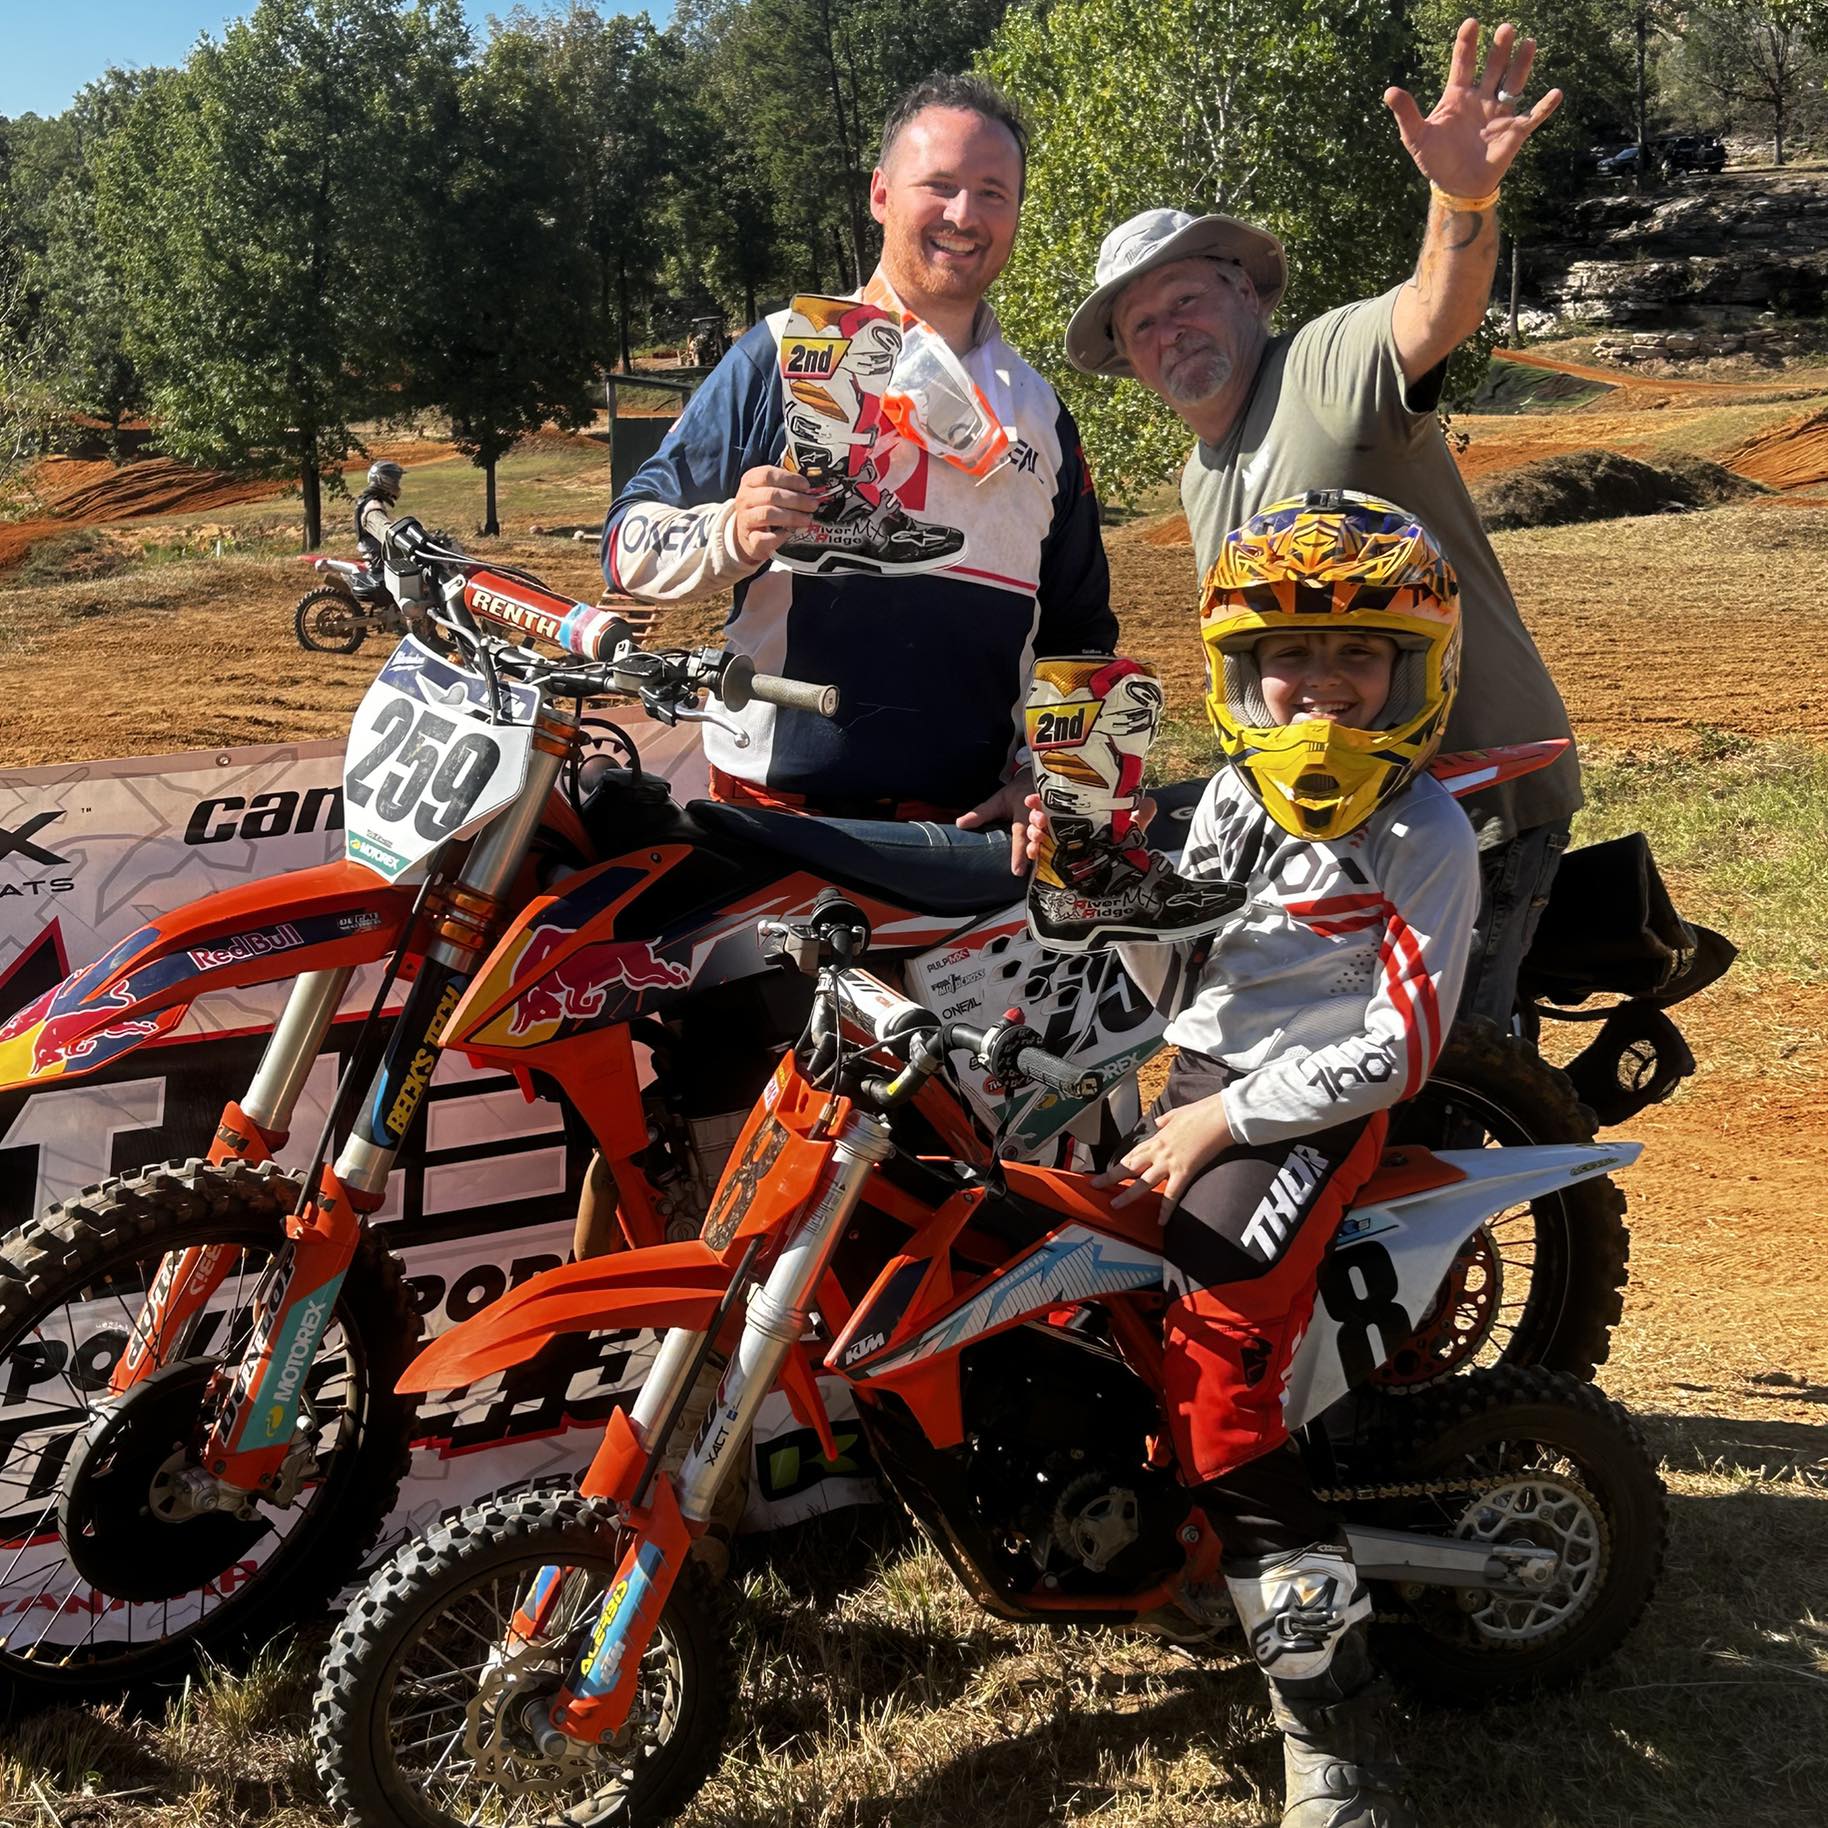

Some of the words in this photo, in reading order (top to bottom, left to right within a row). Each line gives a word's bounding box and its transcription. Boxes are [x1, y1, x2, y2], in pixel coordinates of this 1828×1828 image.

[787, 343, 834, 374] 2nd
[815, 533, 862, 545] Ridge
[852, 519, 885, 541] MX
[471, 589, 562, 641] RENTH
[1035, 707, 1086, 743] 2nd
[346, 697, 501, 842] 259
[359, 840, 401, 871] MOTOREX
[0, 877, 75, 897] ATS
[1123, 886, 1158, 909] MX
[186, 935, 250, 973] Red
[249, 923, 304, 957] Bull
[1097, 1052, 1141, 1083] OREX
[704, 1115, 791, 1250] 8
[1240, 1146, 1332, 1262] THOR
[1317, 1241, 1412, 1391] 8
[273, 1300, 327, 1403] MOTOREX
[845, 1330, 886, 1366] KTM
[704, 1425, 730, 1468] XACT
